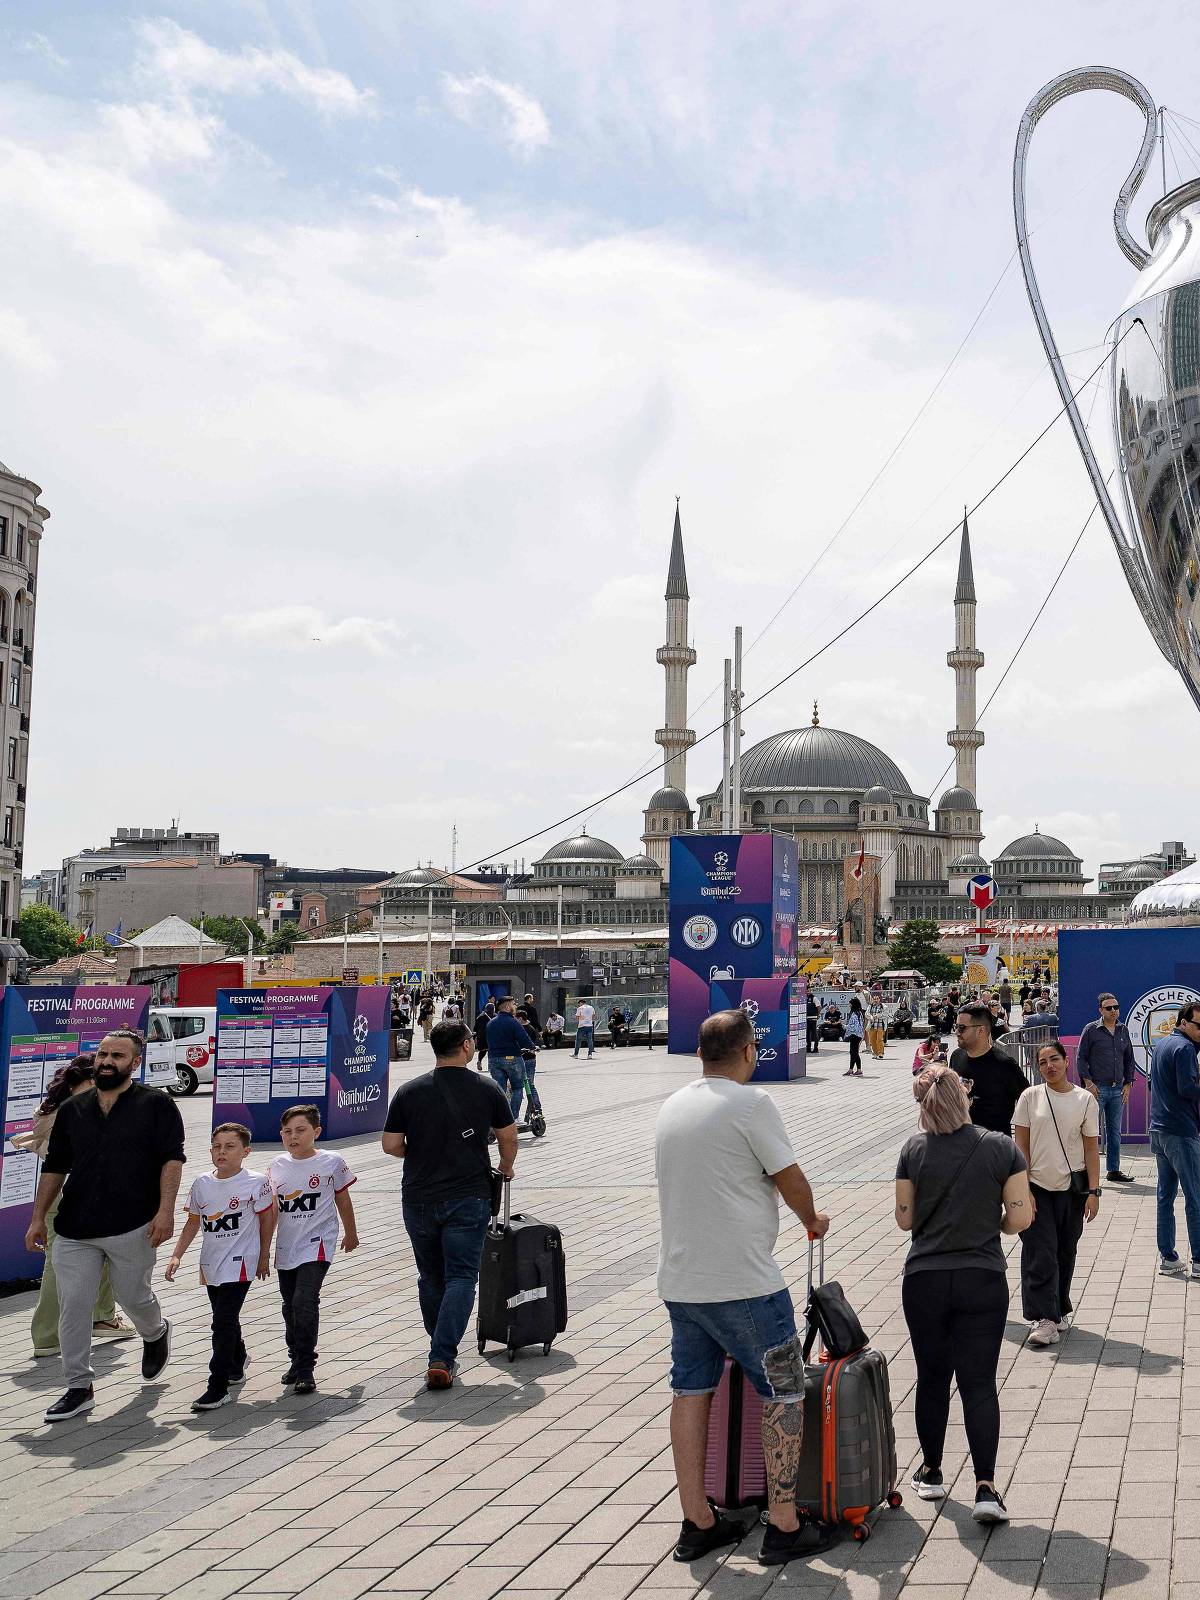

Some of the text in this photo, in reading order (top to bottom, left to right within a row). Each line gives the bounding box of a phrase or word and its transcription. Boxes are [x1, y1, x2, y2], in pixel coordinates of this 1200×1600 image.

[229, 994, 319, 1004] FESTIVAL PROGRAMME
[27, 998, 135, 1012] FESTIVAL PROGRAMME
[1134, 990, 1200, 1023] MANCHES
[55, 1017, 71, 1025] Doors
[86, 1016, 108, 1024] 11:00am
[344, 1054, 377, 1066] CHAMPIONS
[349, 1065, 371, 1074] LEAGUE
[349, 1104, 369, 1114] FINAL
